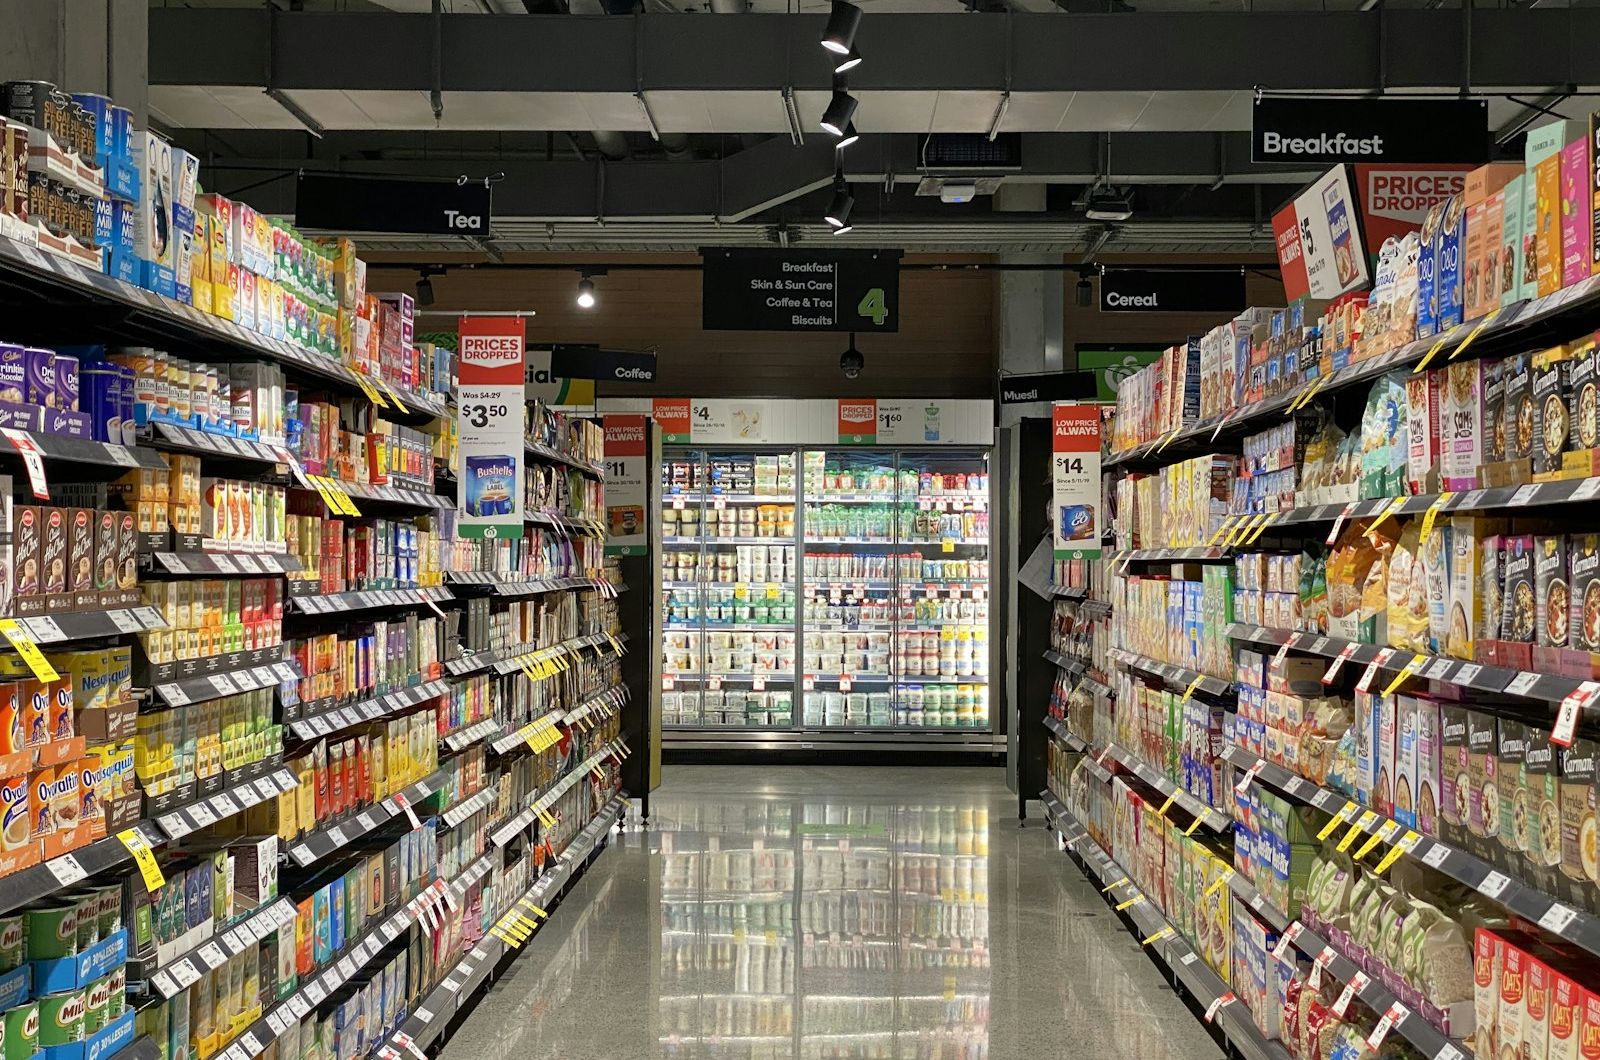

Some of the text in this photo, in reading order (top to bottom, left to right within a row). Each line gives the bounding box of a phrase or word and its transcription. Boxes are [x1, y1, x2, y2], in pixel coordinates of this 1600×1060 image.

[1263, 131, 1383, 155] Breakfast
[1373, 176, 1466, 195] PRICES
[444, 210, 481, 229] Tea
[782, 262, 833, 273] Breakfast
[751, 279, 833, 291] Skin & Sun Care
[766, 297, 833, 308] Coffee & Tea
[1106, 291, 1158, 307] Cereal
[858, 288, 888, 325] 4
[792, 315, 833, 326] Biscuits
[465, 339, 519, 350] PRICES
[464, 351, 519, 360] DROPPED
[615, 367, 652, 380] Coffee
[480, 391, 501, 399] $4.29
[1004, 389, 1038, 401] Muesli
[655, 411, 689, 419] ALWAYS
[842, 406, 873, 414] PRICES
[1056, 419, 1098, 427] LOW PRICE
[605, 426, 644, 434] LOW PRICE
[1055, 426, 1098, 436] ALWAYS
[605, 433, 644, 441] ALWAYS
[477, 464, 513, 479] Bushells
[606, 461, 625, 476] $11
[1056, 457, 1083, 474] $14
[487, 483, 504, 491] LABEL
[1476, 955, 1490, 976] OATS
[1503, 970, 1521, 992] OATS
[1528, 985, 1544, 1008] OATS
[1552, 1002, 1571, 1026] OATS
